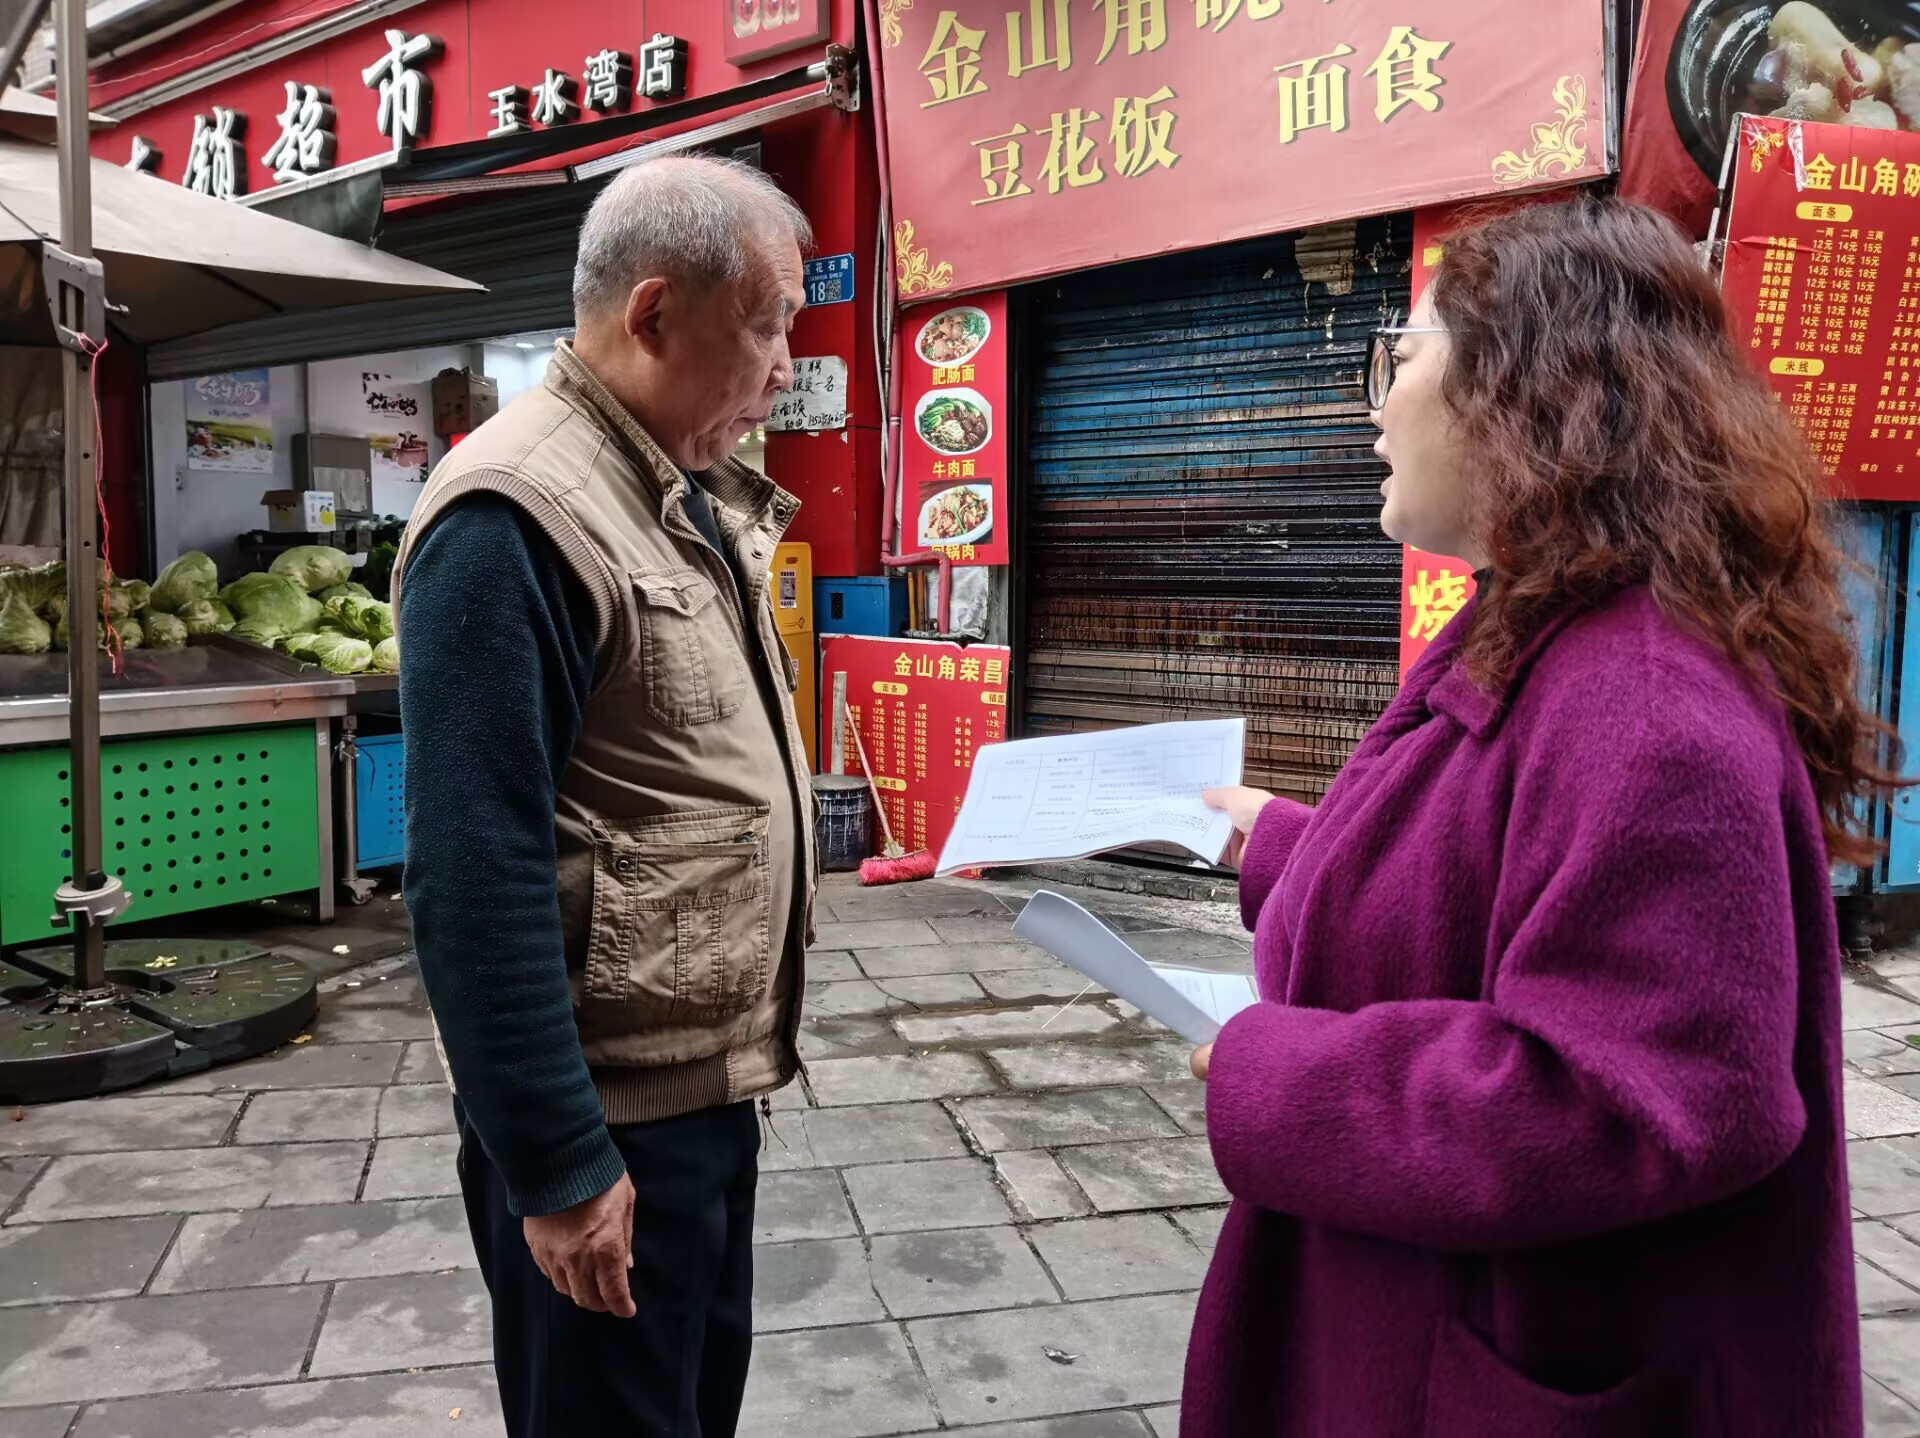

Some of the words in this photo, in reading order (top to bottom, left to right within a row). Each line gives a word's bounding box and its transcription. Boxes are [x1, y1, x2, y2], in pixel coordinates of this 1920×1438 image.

[488, 33, 680, 138] 玉水湾店
[971, 86, 1180, 206] 豆花饭
[1274, 25, 1452, 145] 面食
[1812, 205, 1837, 219] 面条
[1816, 228, 1834, 238] 一两
[1841, 229, 1859, 240] 二两
[1866, 230, 1884, 241] 三两
[1813, 239, 1833, 250] 12元
[1838, 241, 1858, 252] 14元
[1863, 242, 1882, 253] 15元
[1811, 252, 1832, 263] 12元
[1836, 254, 1855, 264] 14元
[1861, 256, 1880, 267] 15元
[1808, 265, 1829, 276] 14元
[1834, 267, 1853, 278] 16元
[1859, 269, 1878, 279] 18元
[810, 281, 826, 302] 18
[1806, 278, 1826, 289] 12元
[1832, 279, 1851, 290] 14元
[1856, 281, 1875, 292] 15元
[1804, 291, 1824, 302] 11元
[1829, 293, 1848, 303] 13元
[1854, 294, 1873, 305] 14元
[1802, 303, 1822, 314] 11元
[1827, 305, 1846, 316] 13元
[1851, 307, 1870, 317] 14元
[1800, 316, 1820, 327] 14元
[1825, 318, 1844, 329] 16元
[1849, 319, 1868, 330] 18元
[1802, 329, 1817, 339] 7元
[1826, 331, 1841, 341] 8元
[1850, 332, 1865, 342] 9元
[1795, 341, 1815, 352] 10元
[1820, 343, 1839, 354] 14元
[1843, 344, 1863, 355] 18元
[1785, 360, 1809, 373] 米线
[932, 363, 976, 386] 肥肠面
[1883, 371, 1920, 382] 鸡杂
[1795, 381, 1813, 392] 一两
[1818, 382, 1836, 392] 二两
[1840, 383, 1858, 393] 三两
[1791, 393, 1812, 404] 12元
[1815, 394, 1834, 404] 14元
[1837, 395, 1856, 405] 15元
[1790, 405, 1809, 416] 12元
[1813, 406, 1832, 417] 14元
[1834, 407, 1853, 417] 15元
[1811, 418, 1829, 429] 16元
[1832, 419, 1850, 429] 18元
[1874, 414, 1920, 426] 西红柿炒蛋
[1807, 430, 1826, 441] 14元
[1829, 431, 1847, 441] 15元
[1826, 442, 1845, 453] 14元
[1822, 454, 1841, 464] 14元
[932, 459, 976, 479] 牛肉面
[1407, 569, 1467, 642] 烧
[894, 651, 1003, 685] 金山角荣昌
[882, 684, 898, 693] 面条
